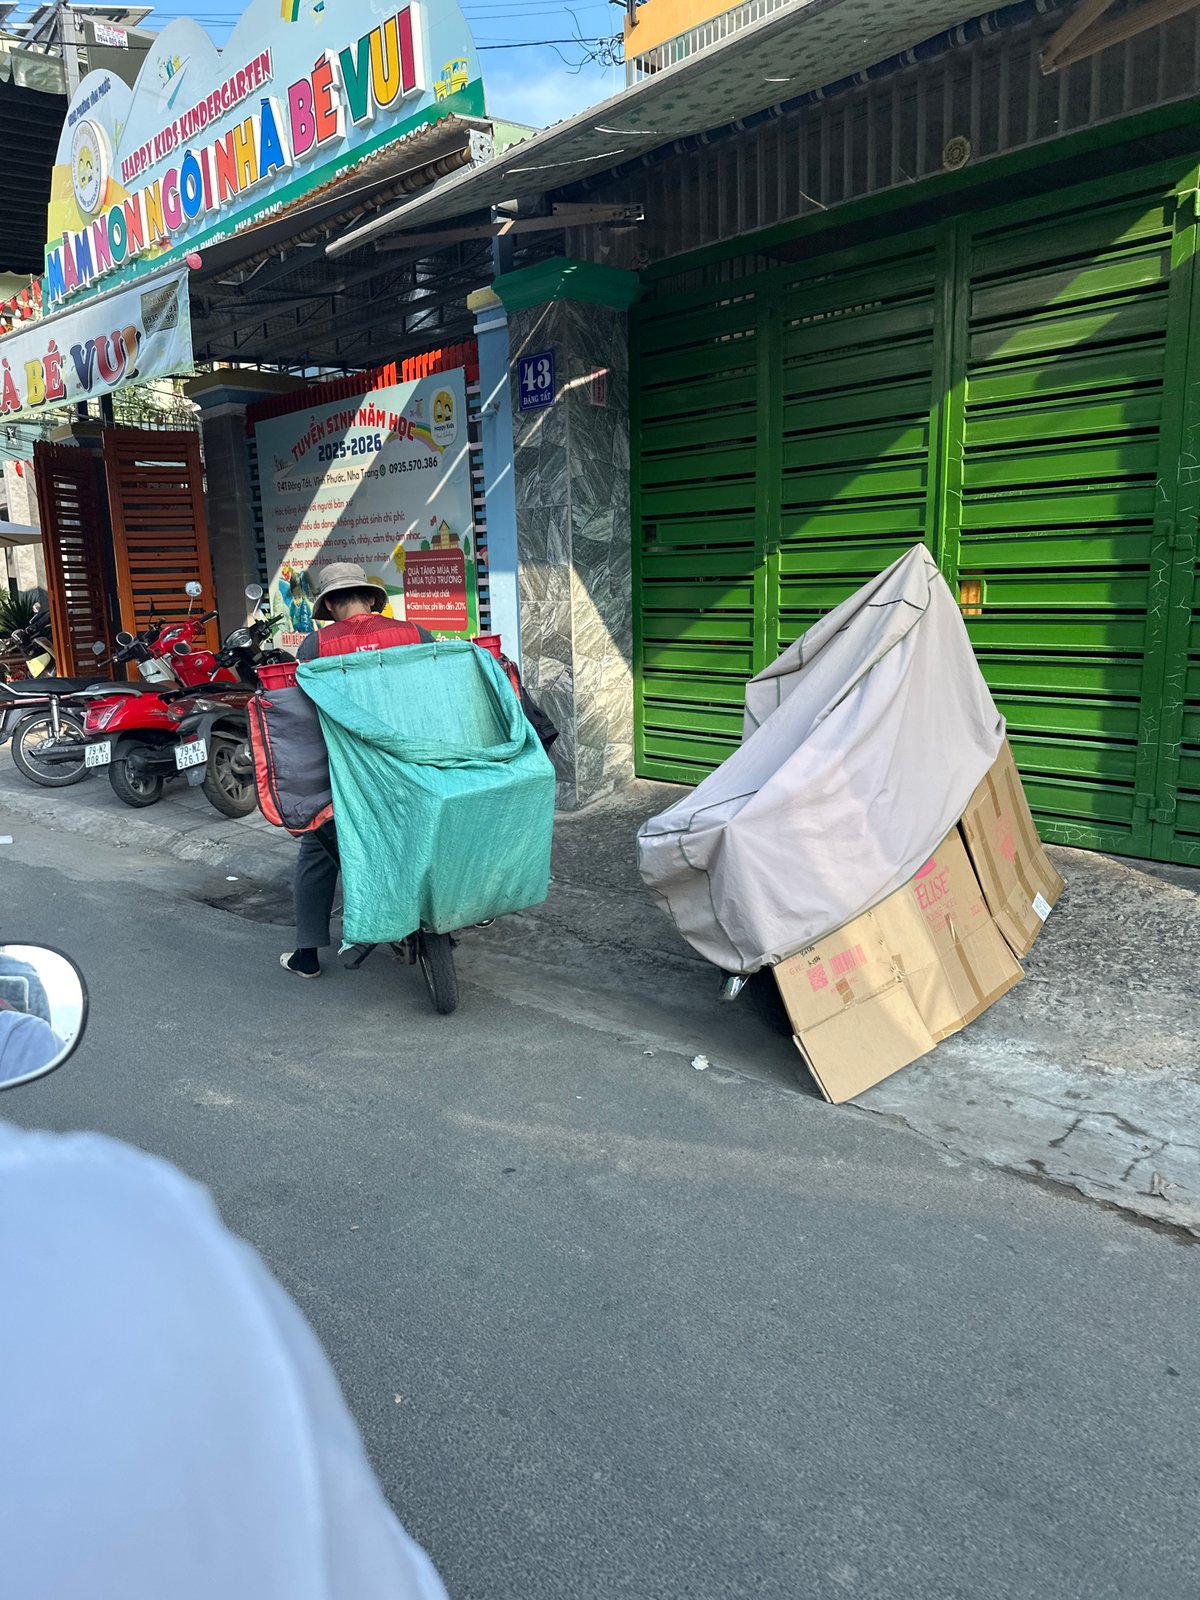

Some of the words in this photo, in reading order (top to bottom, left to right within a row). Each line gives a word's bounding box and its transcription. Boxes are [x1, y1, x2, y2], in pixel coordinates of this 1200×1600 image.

[121, 139, 153, 183] HAPPY
[153, 121, 179, 160] KIDS
[178, 48, 271, 141] KINDERGARTEN
[47, 228, 95, 301] MẦM
[92, 192, 145, 273] NON
[144, 148, 213, 243] NGÔI
[214, 98, 286, 202] NHÀ
[287, 52, 338, 157] BÉ
[338, 5, 417, 124] VUI
[24, 339, 66, 406] BÉ
[70, 324, 140, 391] VUI
[522, 358, 552, 392] 43
[291, 415, 325, 463] TUYỂN
[326, 408, 357, 435] SINH
[358, 402, 386, 429] NĂM
[388, 412, 416, 442] HỌC
[318, 433, 382, 462] 2025-2026
[347, 471, 360, 482] Nha
[361, 467, 379, 481] Trang
[389, 456, 438, 474] 0935.570.386
[408, 565, 420, 576] QUÀ
[436, 563, 450, 574] MÙA
[451, 563, 459, 574] HÈ
[455, 601, 467, 611] 20%
[178, 752, 206, 768] 526.13
[914, 871, 950, 911] ELISE
